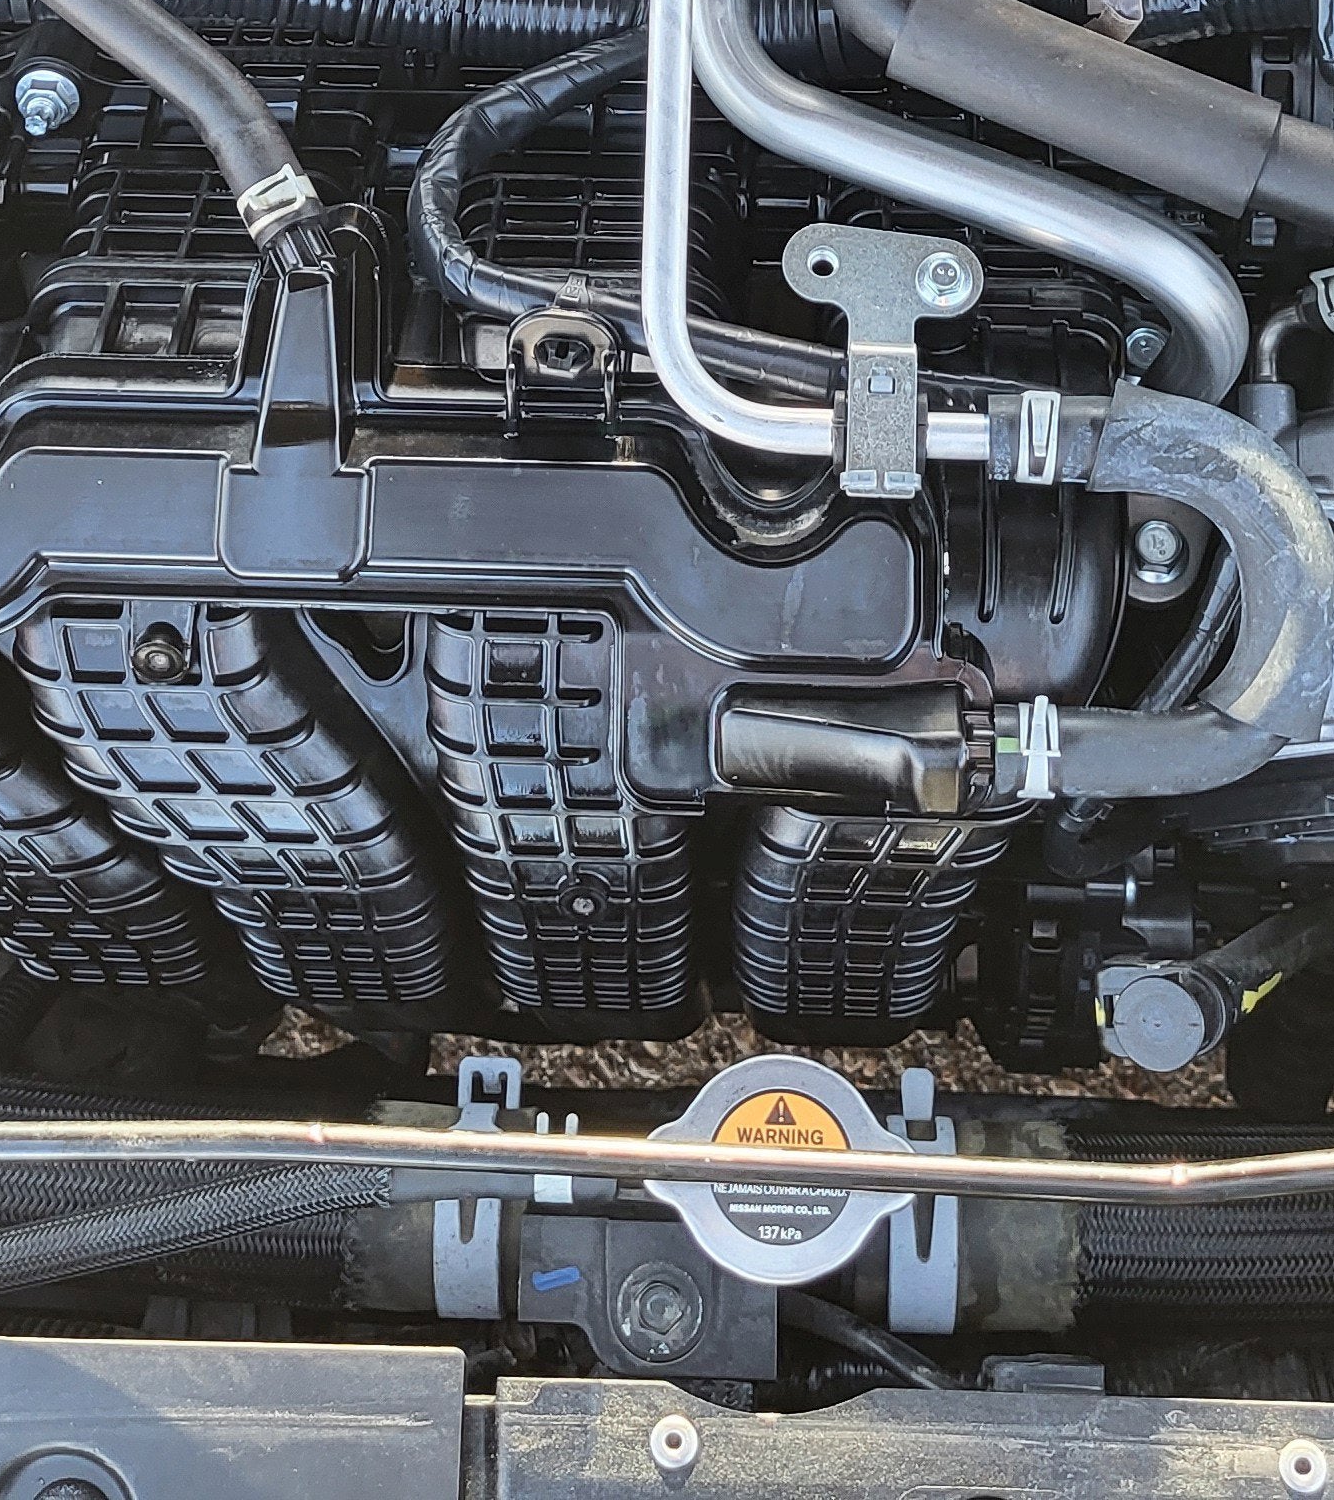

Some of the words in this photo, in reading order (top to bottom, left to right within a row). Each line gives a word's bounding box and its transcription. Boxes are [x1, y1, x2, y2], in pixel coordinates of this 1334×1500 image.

[737, 1127, 824, 1145] WARNING
[729, 1203, 763, 1213] NISSAN
[763, 1204, 794, 1214] MOTOR
[757, 1225, 780, 1240] 137
[780, 1226, 803, 1240] kPa
